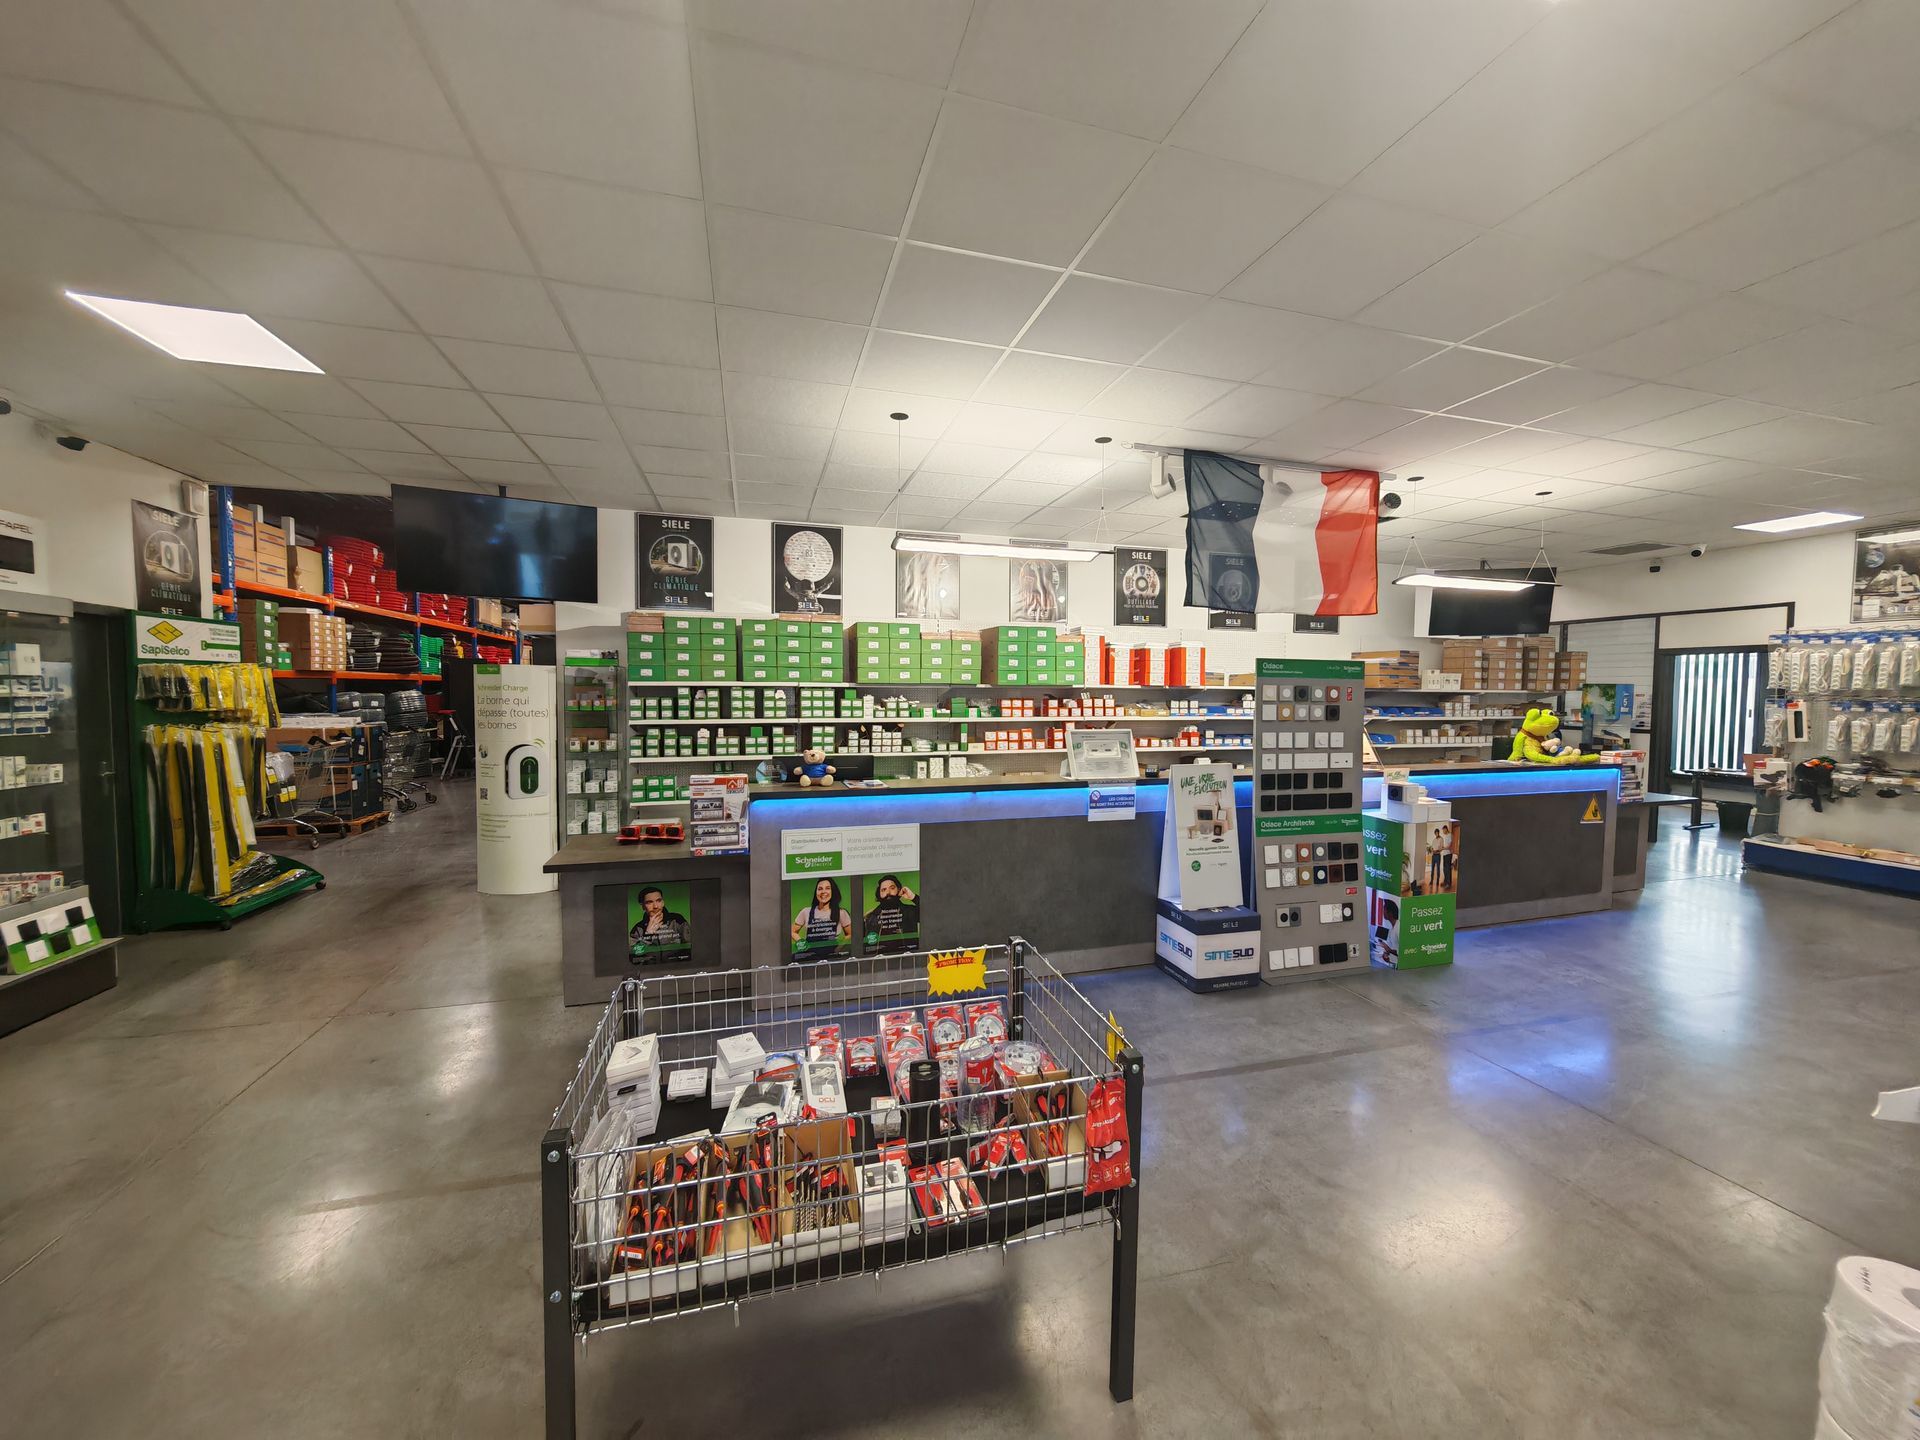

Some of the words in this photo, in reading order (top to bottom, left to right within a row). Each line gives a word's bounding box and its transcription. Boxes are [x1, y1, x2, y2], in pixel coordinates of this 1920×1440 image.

[152, 510, 181, 527] SIELE
[661, 519, 691, 530] SIELE
[1132, 551, 1152, 560] SIELE
[653, 582, 699, 592] CLIMATIQUE
[665, 596, 689, 604] SIELE
[797, 601, 819, 610] SIELE
[141, 643, 190, 656] SapiSelco
[502, 684, 529, 692] Charge
[477, 696, 485, 704] La
[486, 696, 510, 705] borne
[512, 696, 530, 706] qui
[477, 707, 507, 718] dépasse
[509, 708, 549, 718] (toutes)
[487, 720, 517, 729] bornes
[1181, 776, 1196, 789] UNE
[1282, 819, 1315, 827] Architecte
[1362, 828, 1387, 842] ssez
[1366, 843, 1387, 857] vert
[795, 855, 833, 865] Schneider
[1364, 864, 1393, 878] Schneider
[1411, 906, 1443, 918] Passez
[1409, 924, 1421, 933] au
[1424, 919, 1443, 931] vert
[1160, 931, 1193, 959] SIMESUD
[1420, 942, 1447, 952] Schneider
[1204, 947, 1254, 961] SIMESUD
